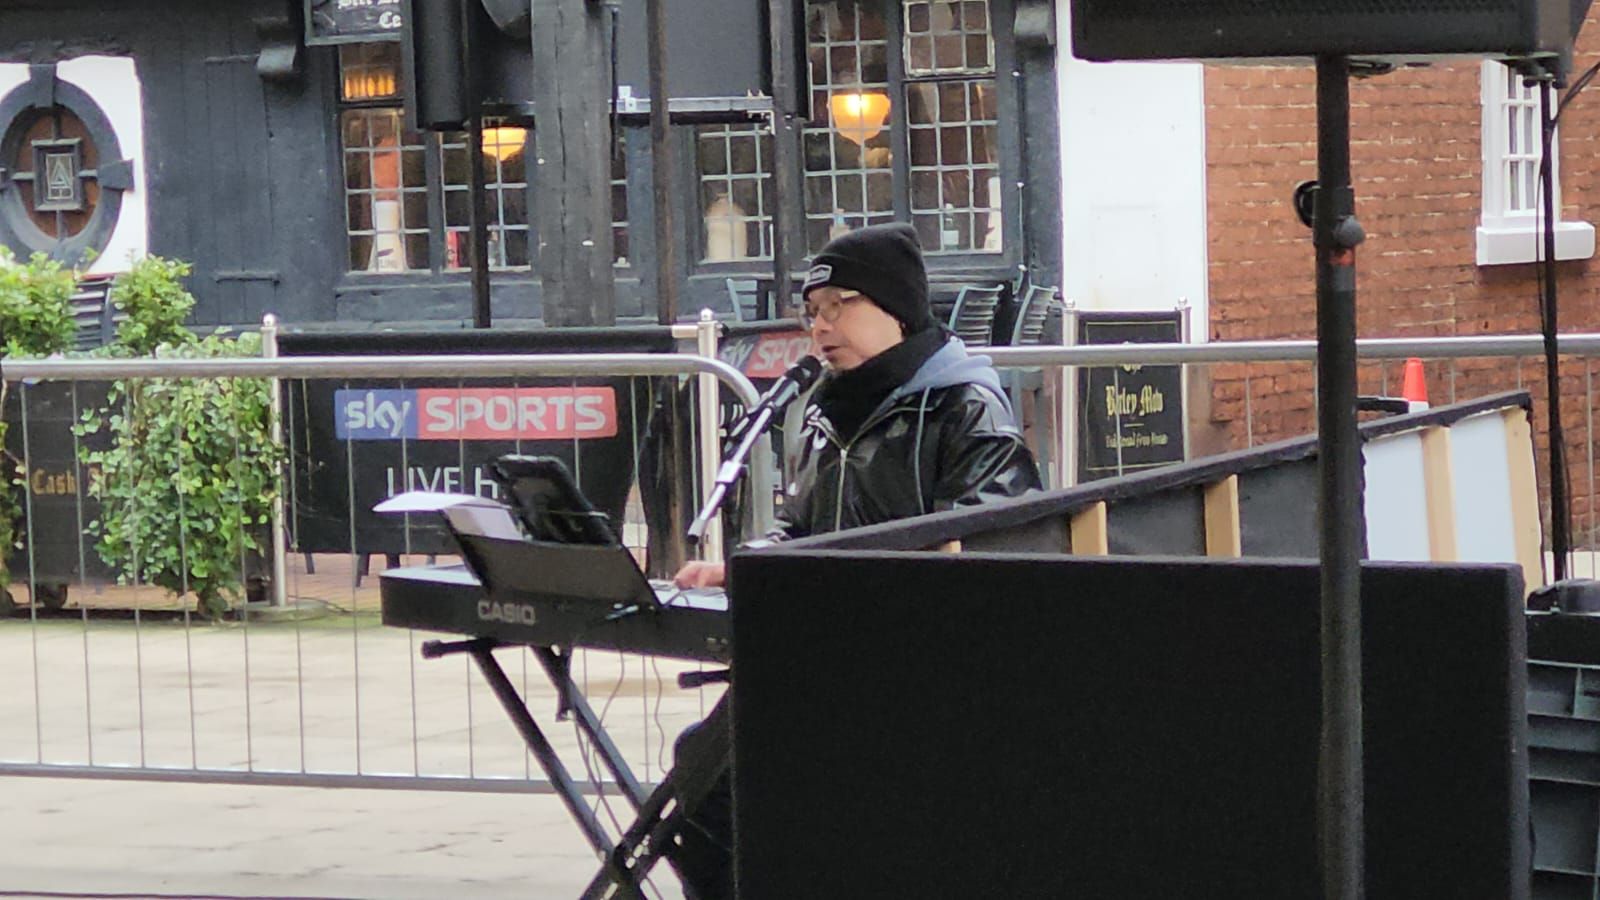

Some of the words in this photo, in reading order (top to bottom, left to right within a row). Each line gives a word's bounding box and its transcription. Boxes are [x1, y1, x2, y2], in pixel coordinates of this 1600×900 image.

[344, 391, 410, 437] sky
[425, 395, 606, 432] SPORTS
[31, 468, 77, 495] Cash
[477, 600, 536, 626] CASIO
